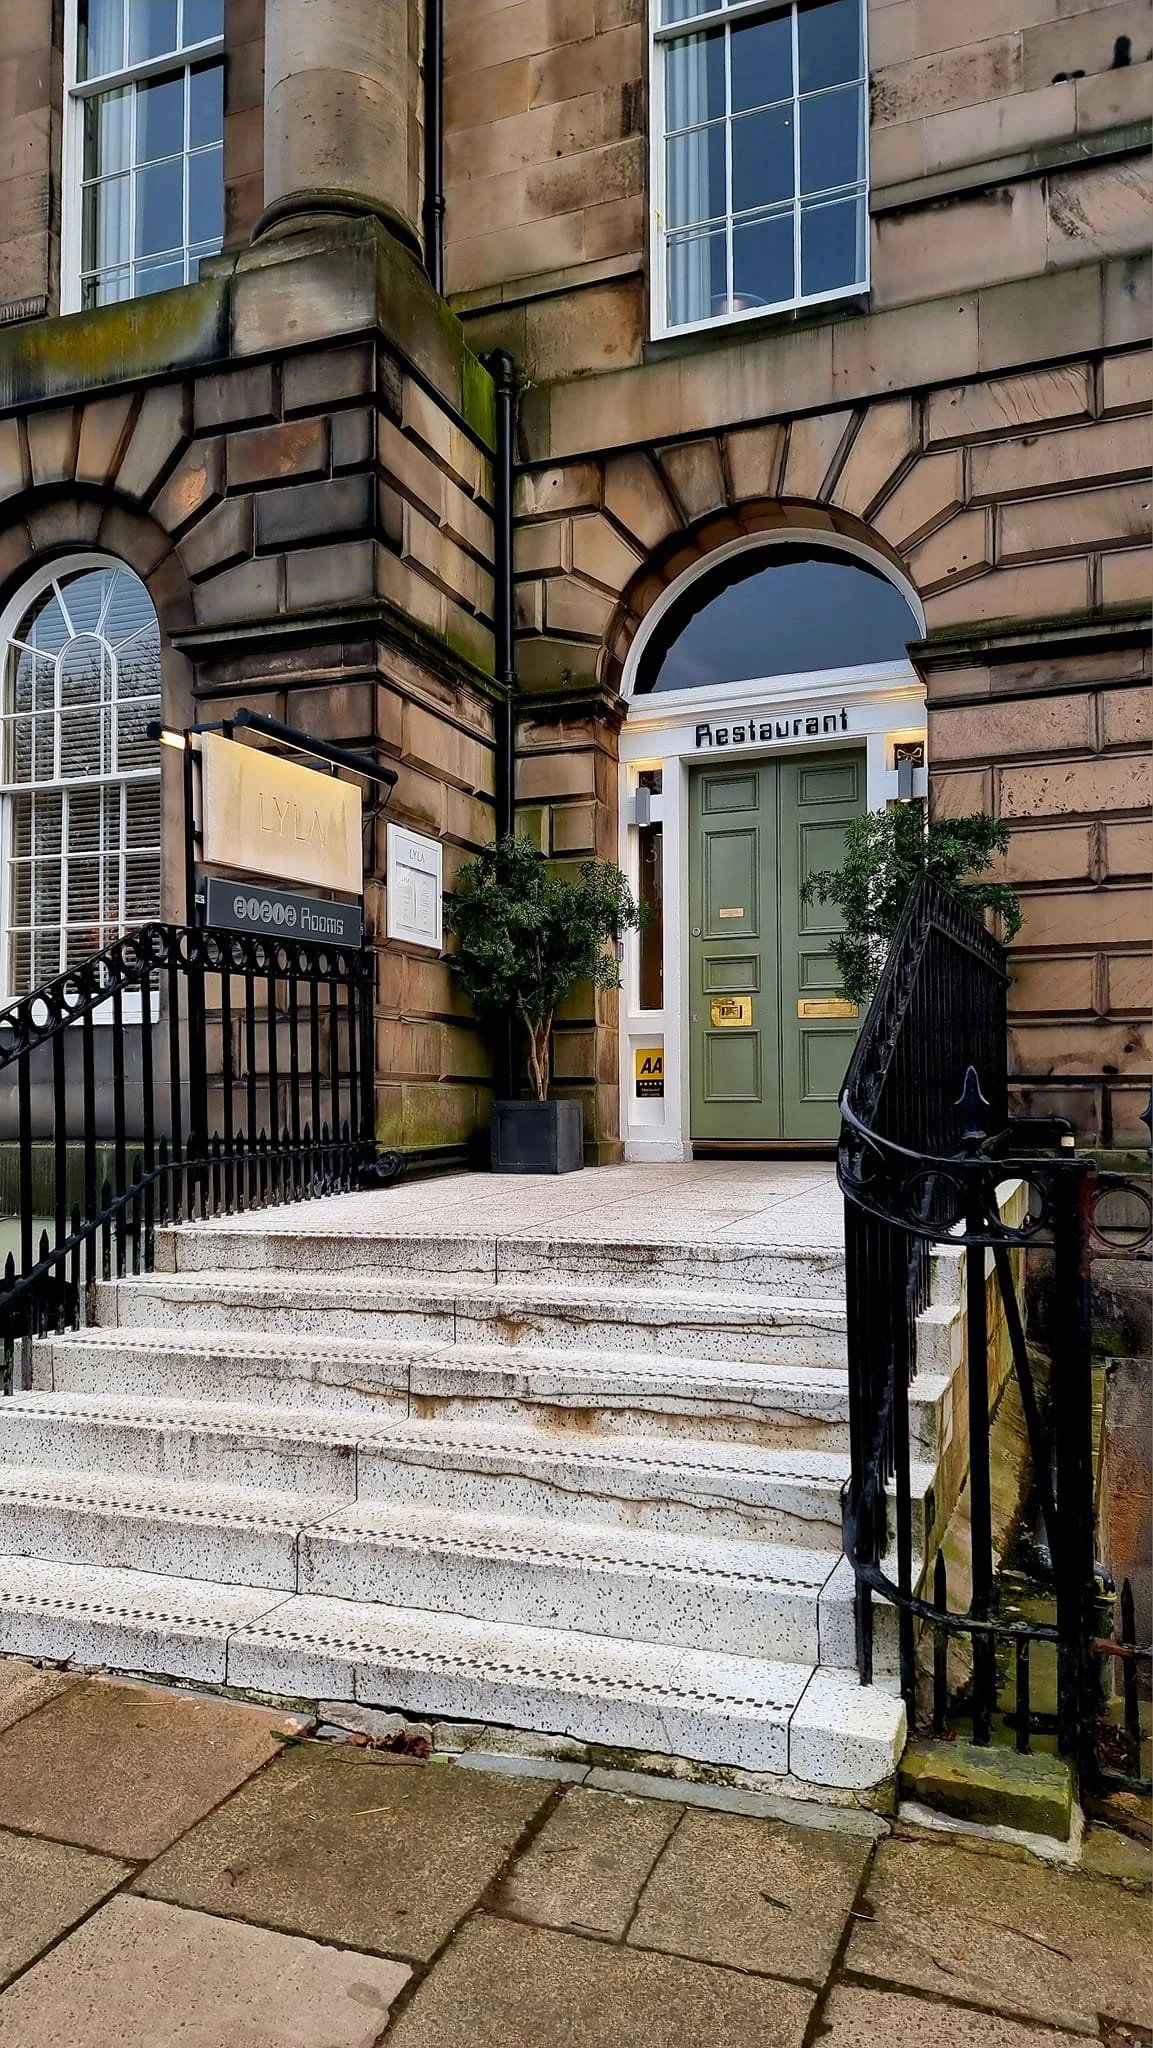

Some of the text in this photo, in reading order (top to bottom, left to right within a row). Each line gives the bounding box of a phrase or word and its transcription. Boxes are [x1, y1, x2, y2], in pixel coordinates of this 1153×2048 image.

[695, 708, 848, 747] Restaurant
[258, 792, 328, 848] LYLA
[409, 848, 425, 863] LYLA
[301, 907, 344, 935] Rooms
[640, 1057, 663, 1074] AA
